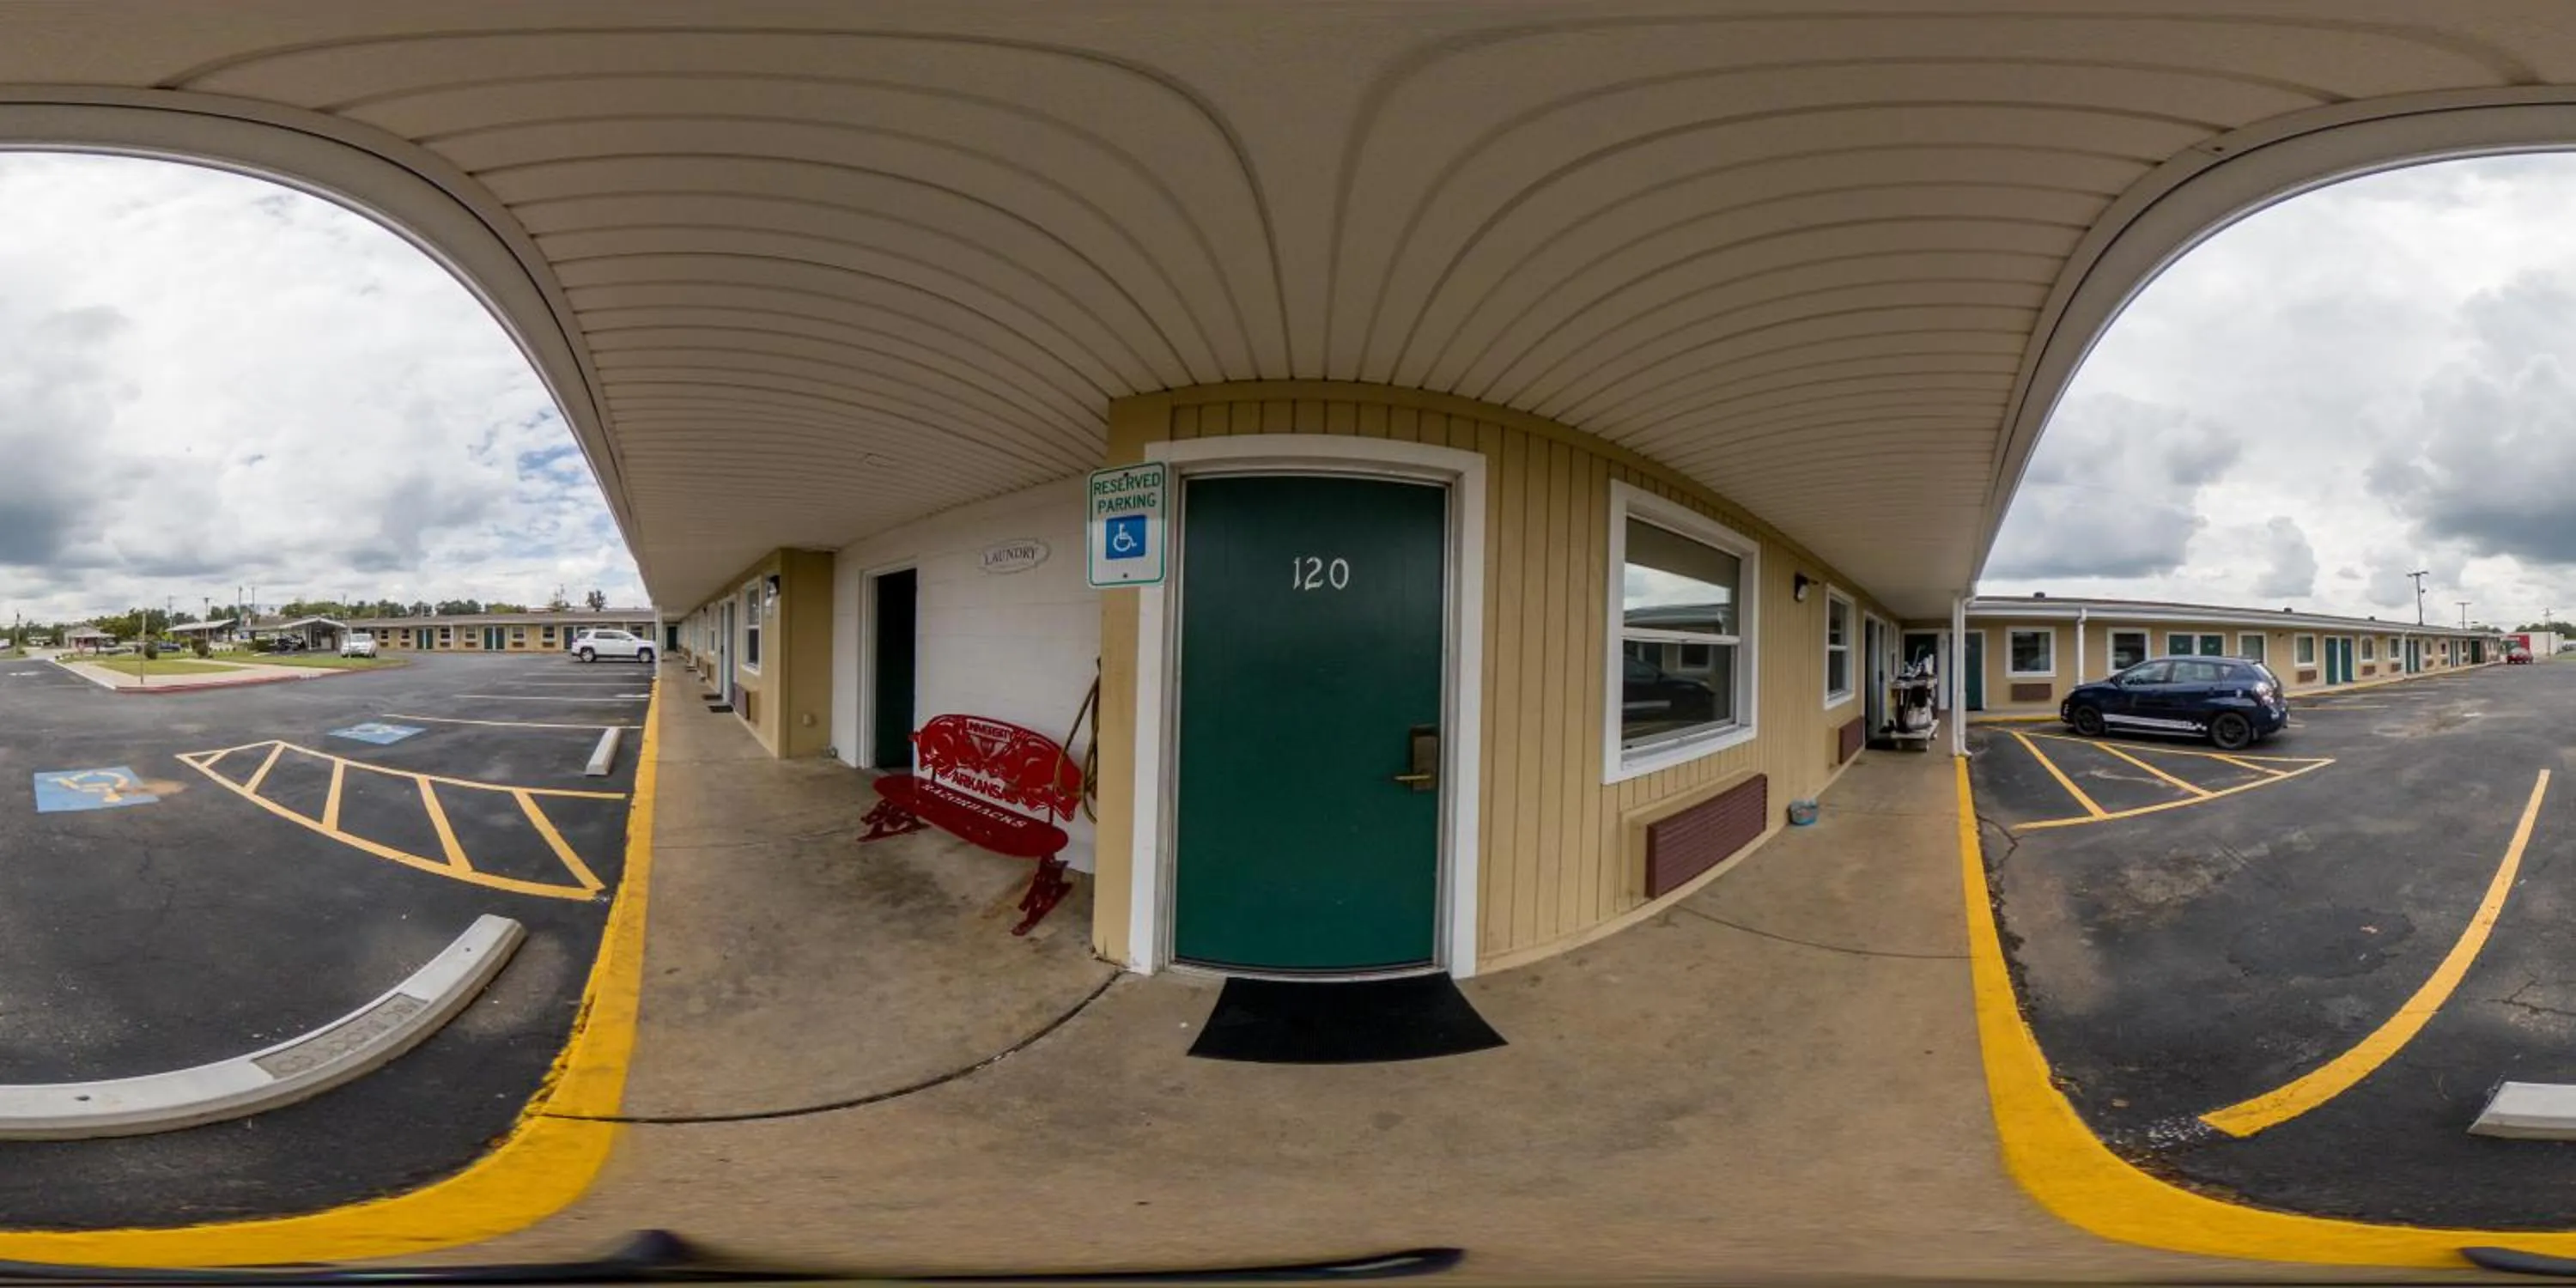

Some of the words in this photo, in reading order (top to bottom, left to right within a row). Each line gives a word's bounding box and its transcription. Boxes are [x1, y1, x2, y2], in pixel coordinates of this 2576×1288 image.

[1093, 472, 1161, 495] RESERVED
[1097, 492, 1157, 513] PARKING
[984, 546, 1037, 565] LAUNDRY
[1292, 556, 1349, 590] 120
